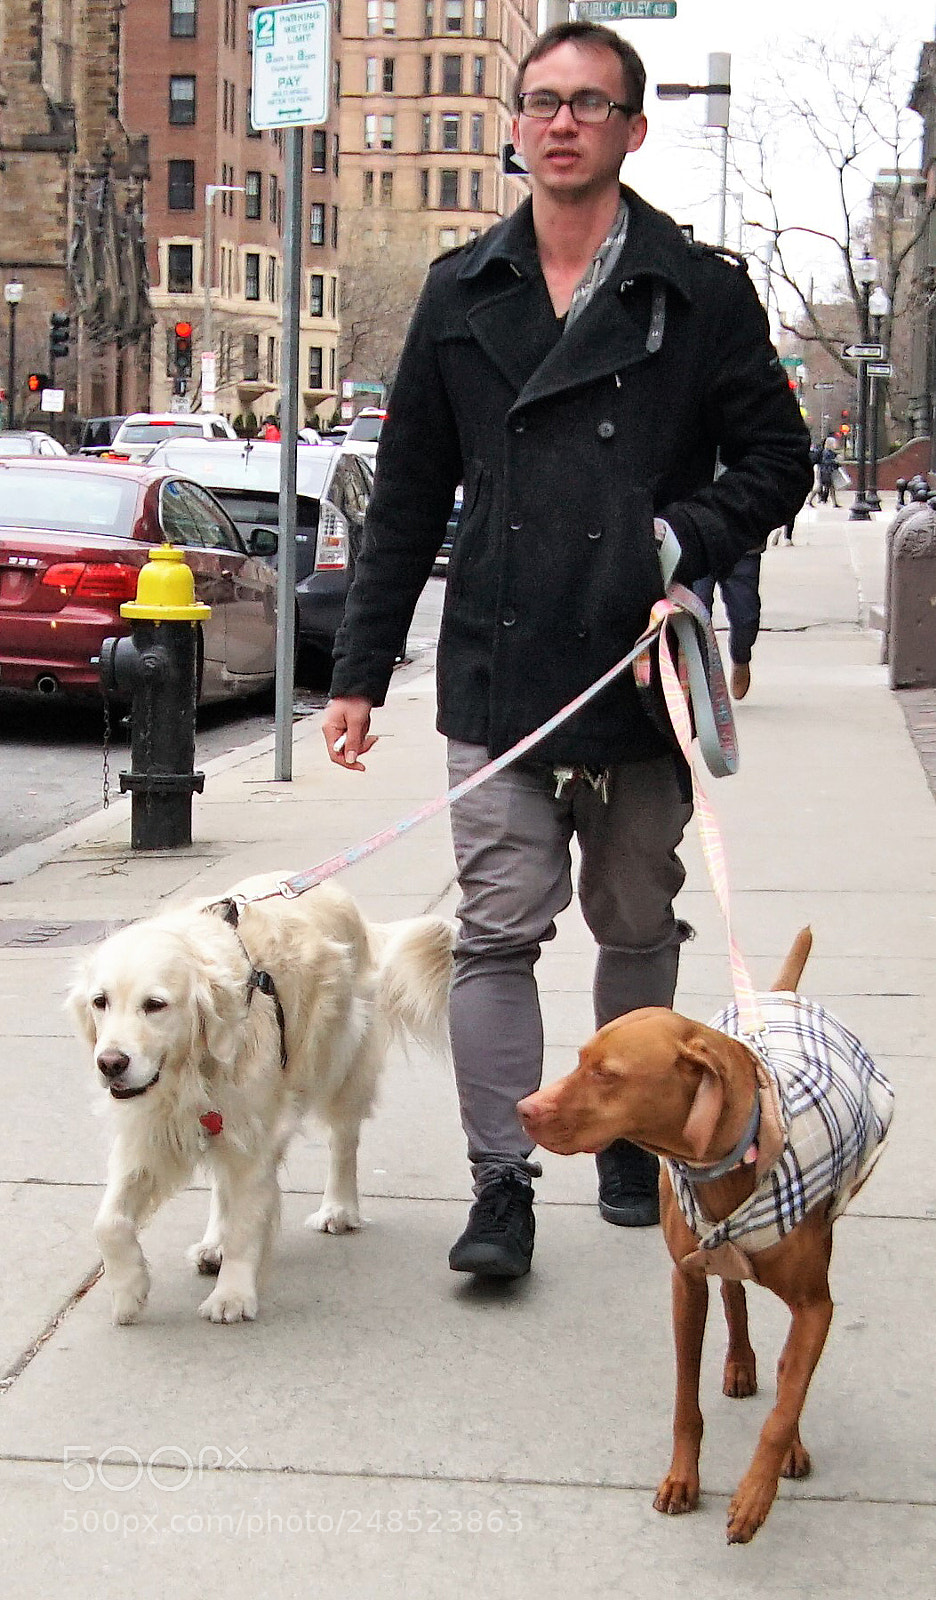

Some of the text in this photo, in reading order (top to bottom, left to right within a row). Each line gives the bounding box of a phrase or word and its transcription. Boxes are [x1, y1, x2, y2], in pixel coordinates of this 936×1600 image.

[579, 2, 616, 17] PUBLIC
[620, 1, 650, 16] ALLEY
[280, 11, 320, 22] PARKING
[259, 13, 273, 38] 2
[285, 23, 314, 33] METER
[288, 33, 312, 44] LIMIT
[278, 76, 300, 88] PAY
